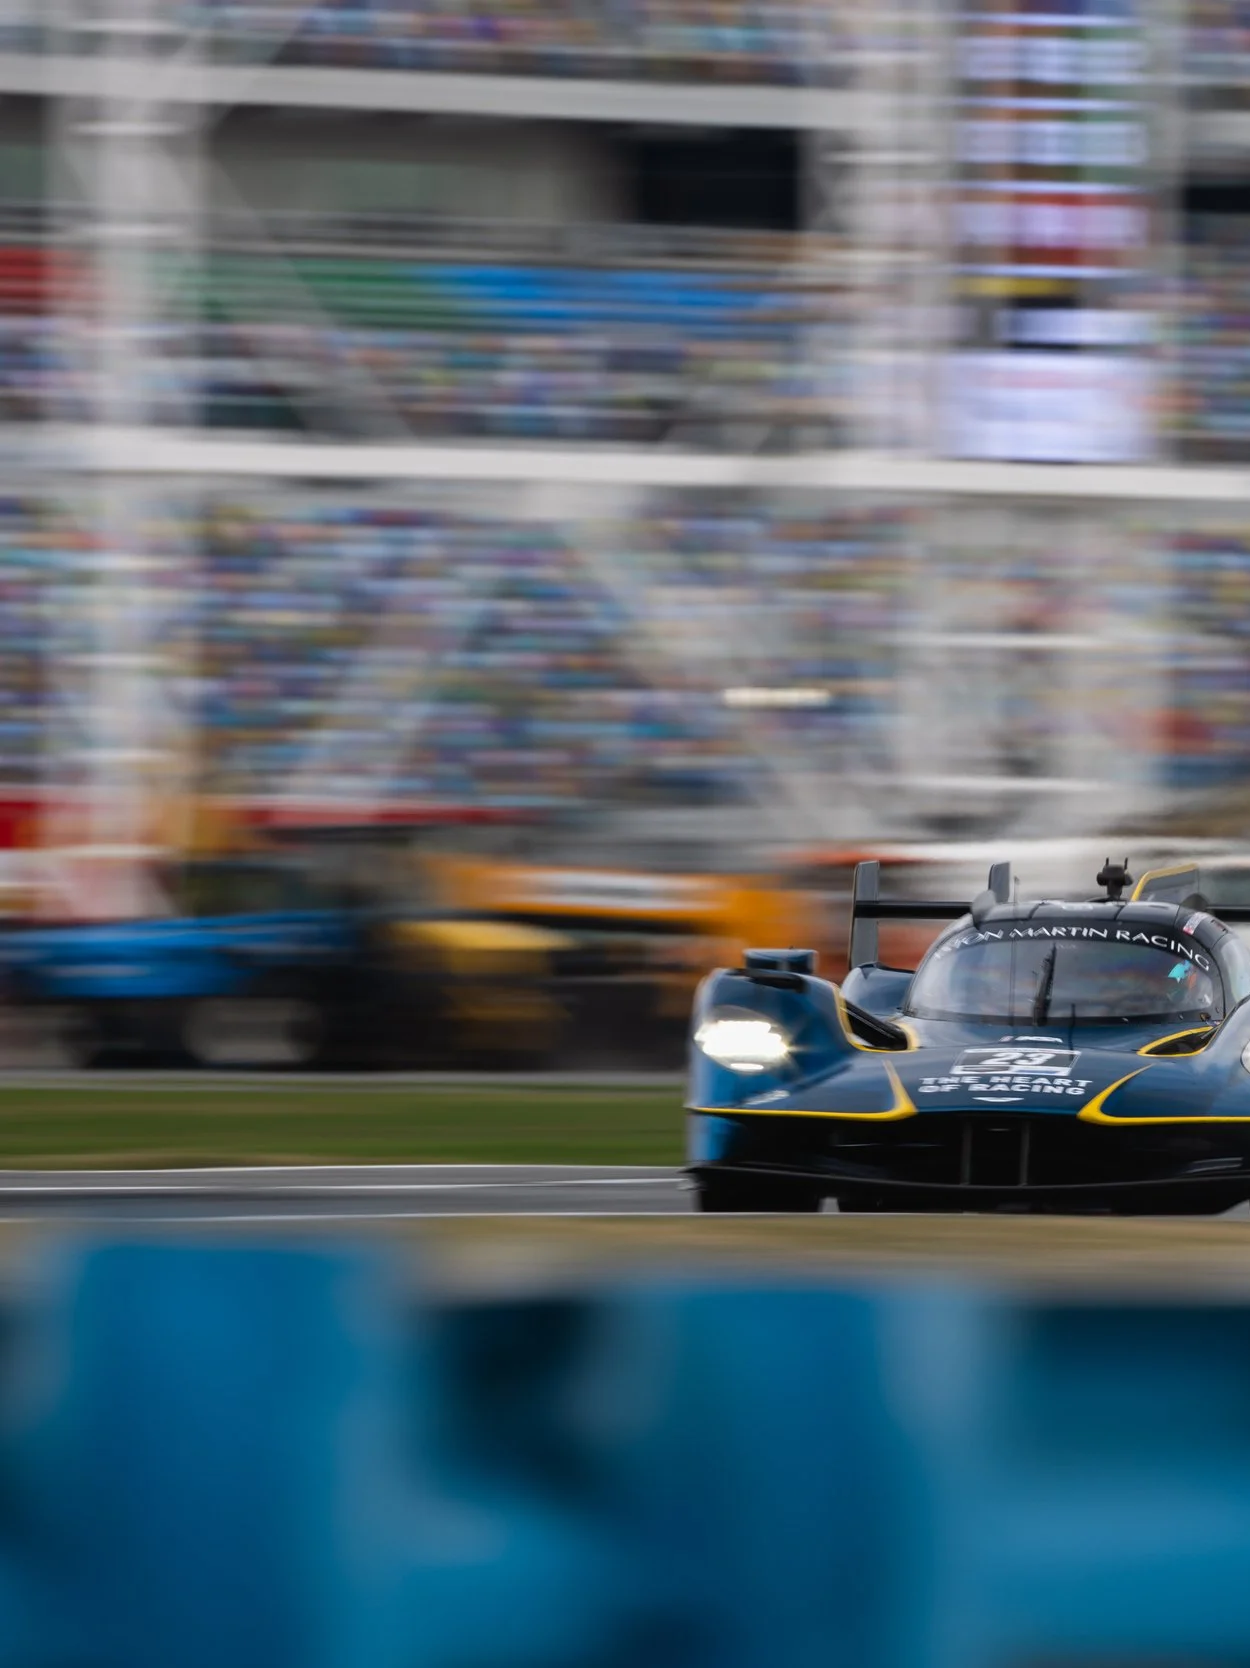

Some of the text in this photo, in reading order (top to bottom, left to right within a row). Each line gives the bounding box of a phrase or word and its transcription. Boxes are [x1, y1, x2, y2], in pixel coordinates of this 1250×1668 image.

[1010, 926, 1109, 939] MARTIN
[1115, 929, 1210, 970] RACING
[980, 1052, 1055, 1066] 23
[919, 1076, 1093, 1087] THE HEART
[918, 1084, 1085, 1095] OF RACING
